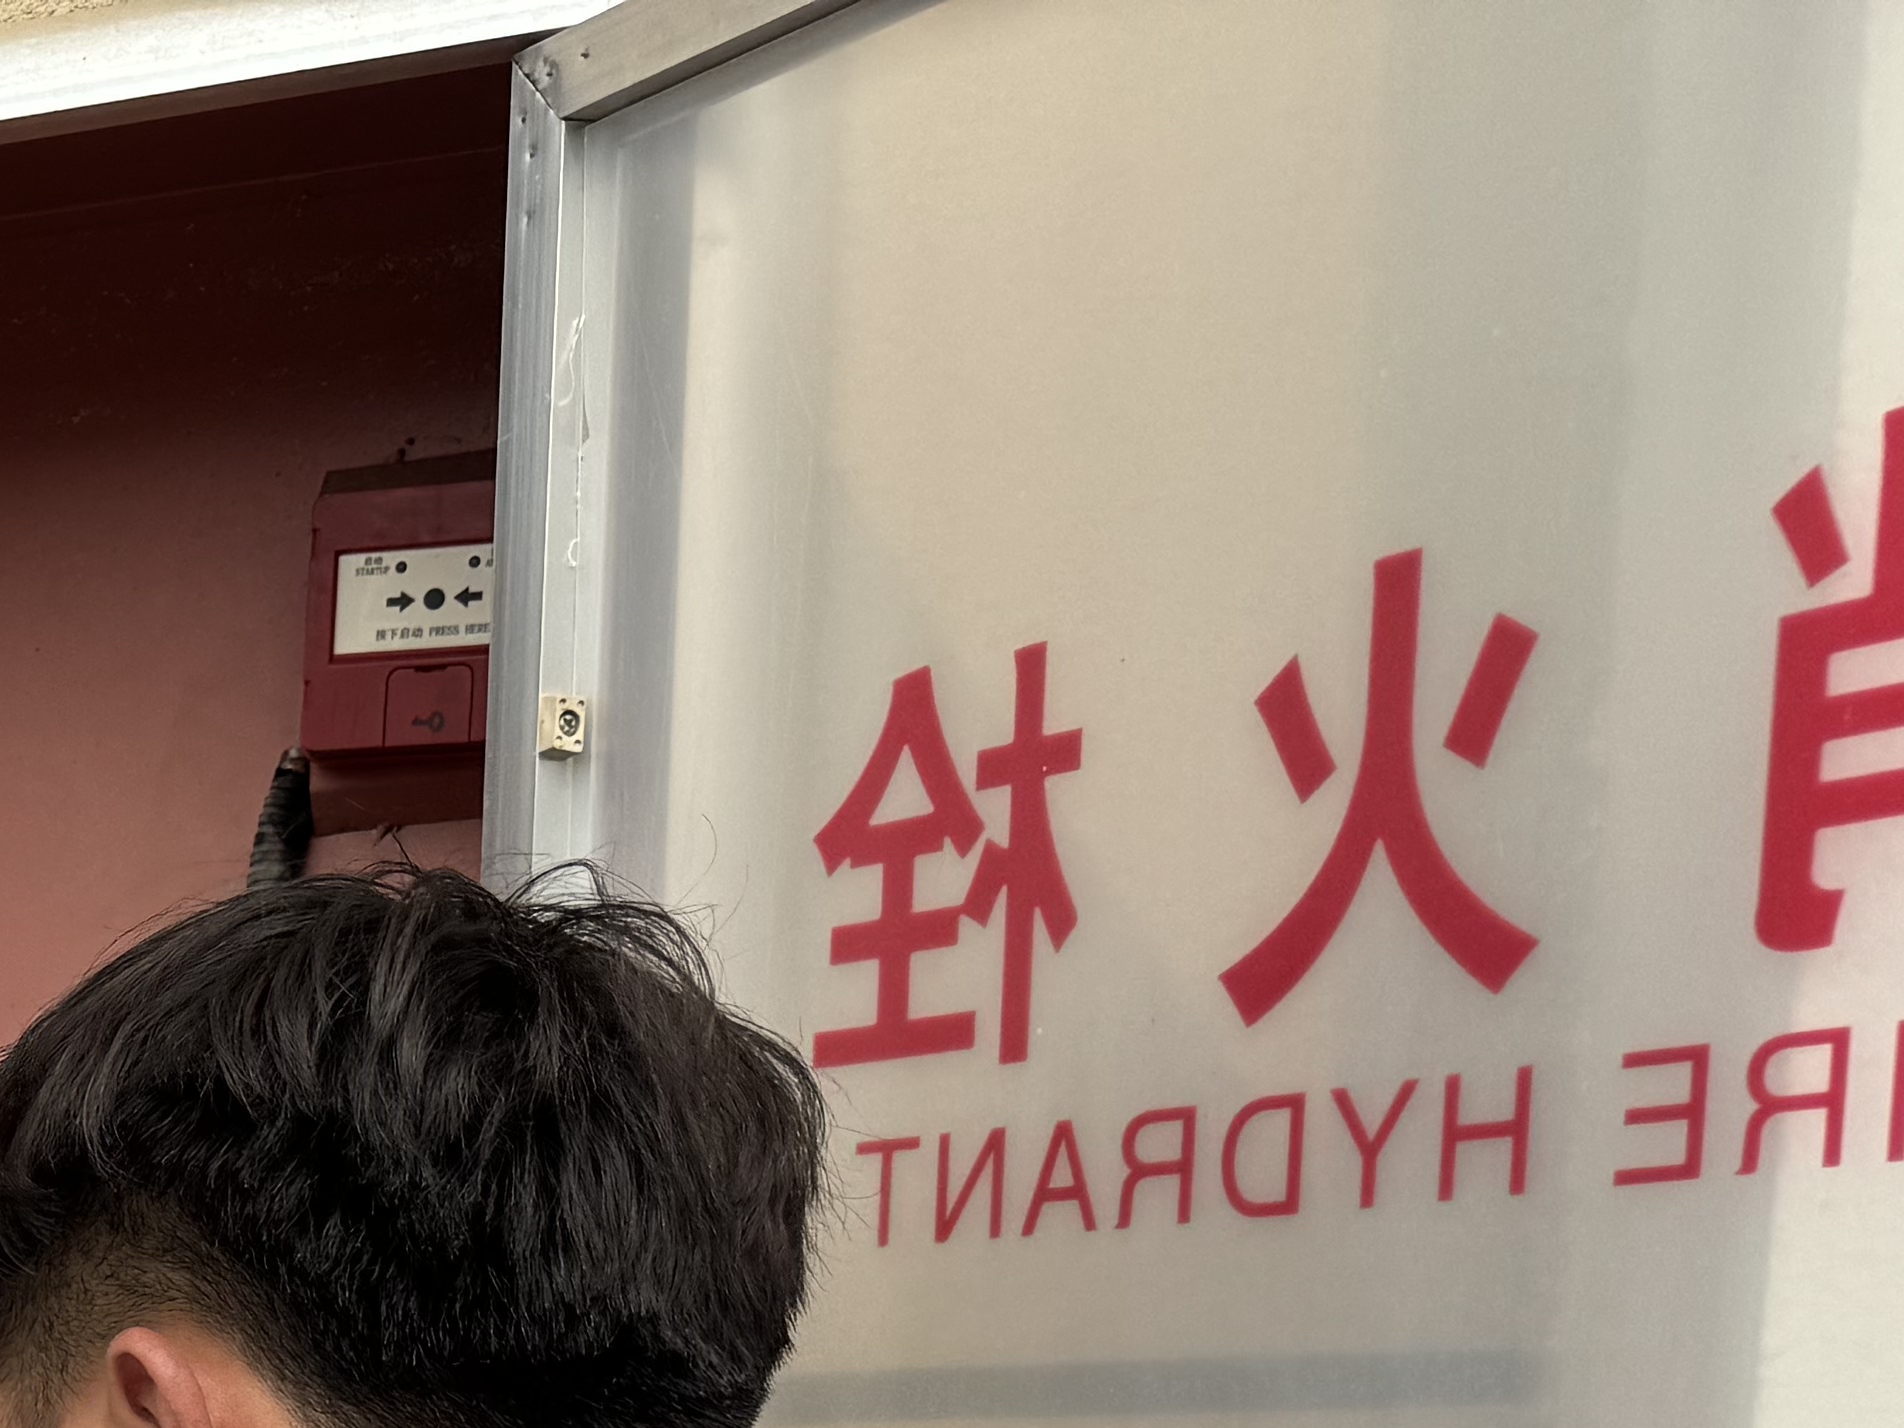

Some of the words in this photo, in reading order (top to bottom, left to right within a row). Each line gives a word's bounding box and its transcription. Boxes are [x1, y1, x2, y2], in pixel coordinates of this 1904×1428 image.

[355, 566, 391, 577] STARTUP
[375, 627, 424, 642] 按下启动
[429, 625, 460, 638] PRESS
[465, 622, 491, 634] HERE
